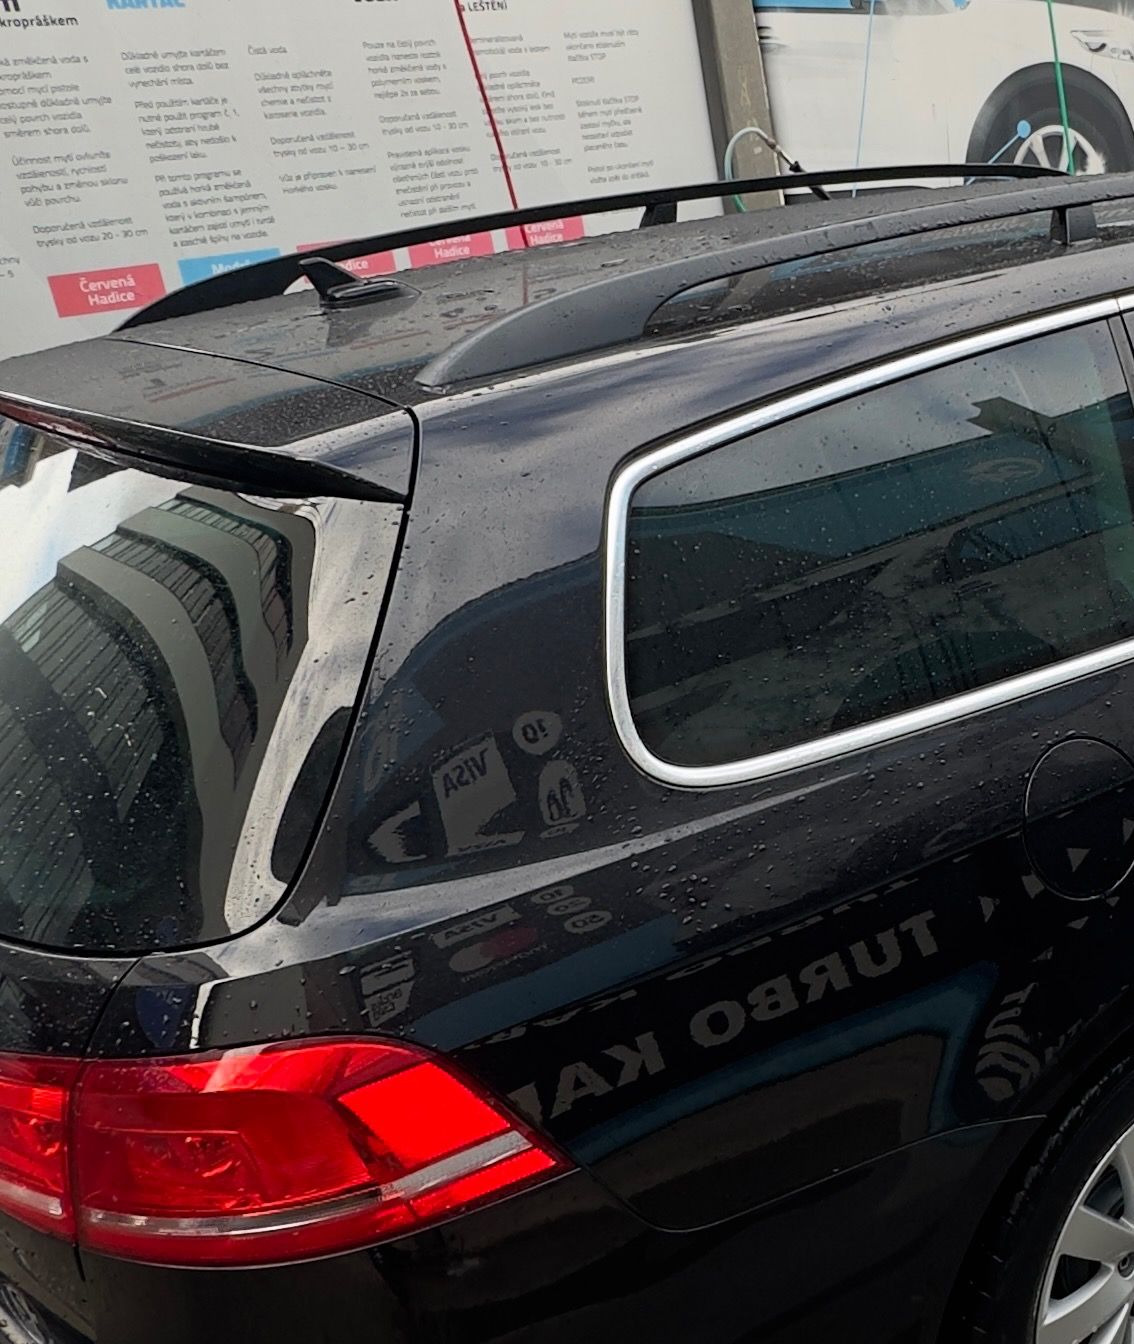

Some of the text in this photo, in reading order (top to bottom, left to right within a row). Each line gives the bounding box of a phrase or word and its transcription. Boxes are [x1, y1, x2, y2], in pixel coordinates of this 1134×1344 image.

[467, 0, 508, 13] LEŠTĚNÍ
[530, 232, 564, 246] Hadice
[434, 245, 470, 259] Hadice
[79, 273, 136, 293] Červená
[88, 291, 136, 307] Hadice
